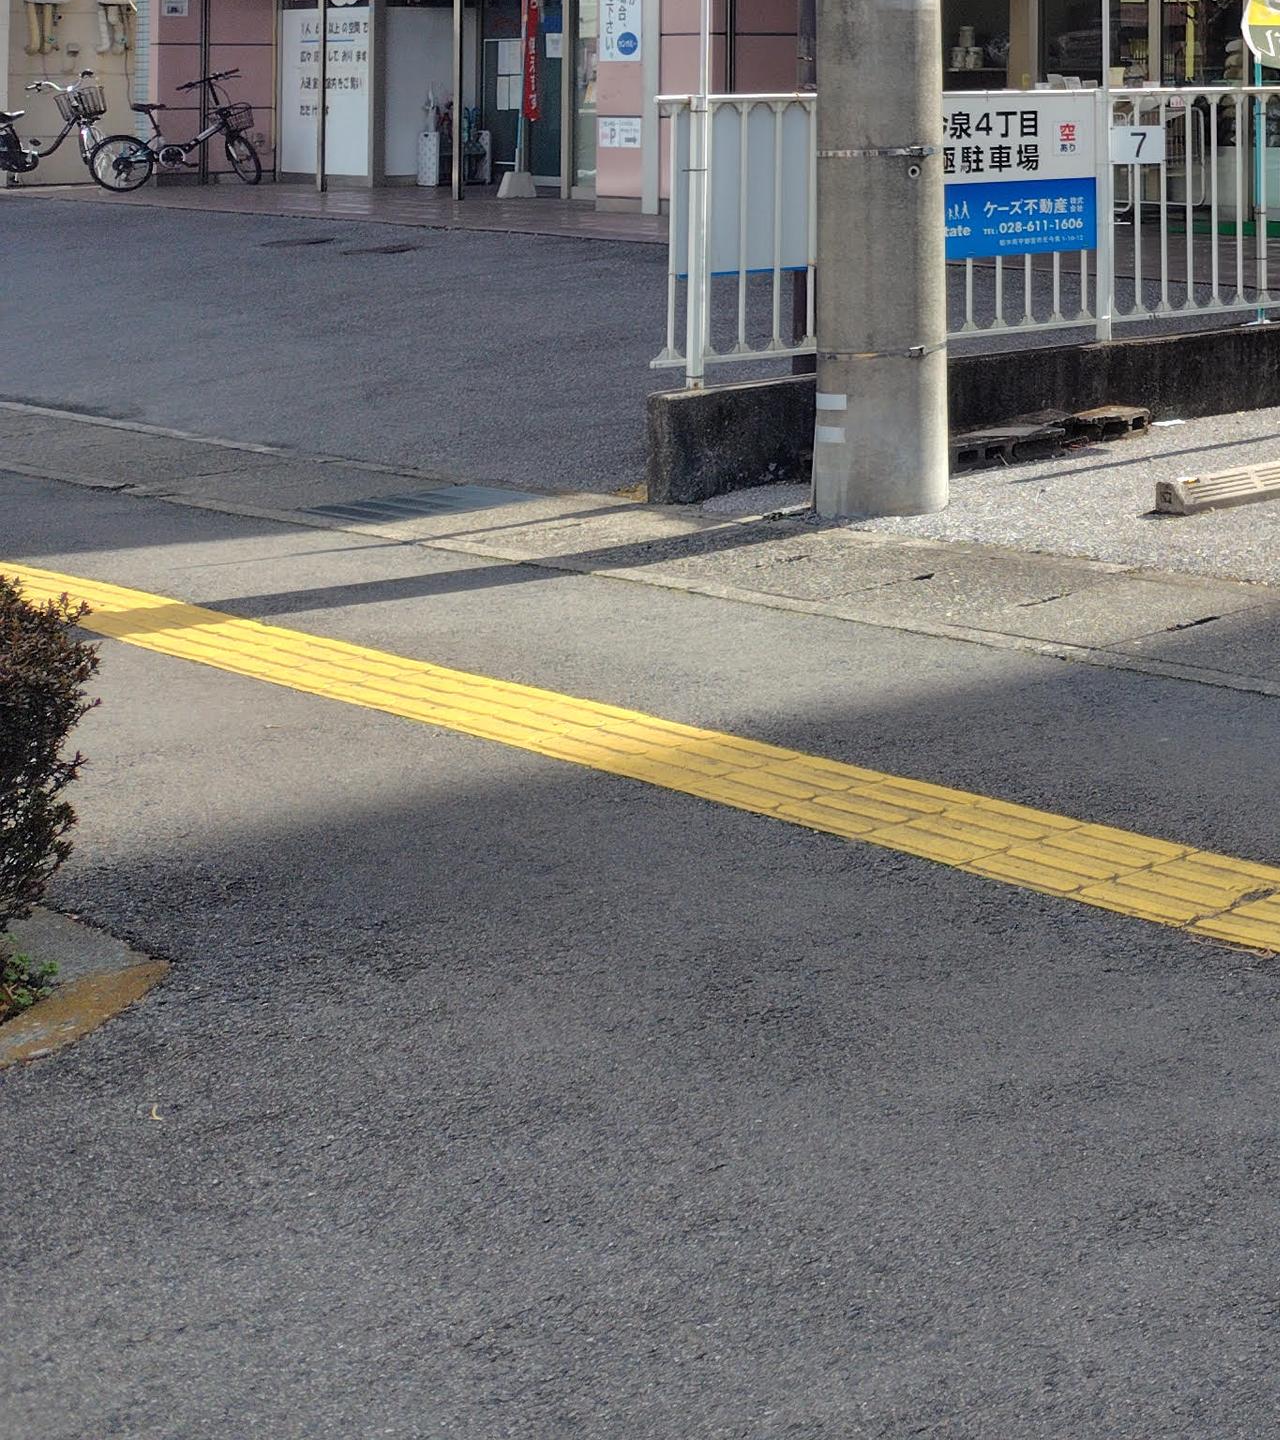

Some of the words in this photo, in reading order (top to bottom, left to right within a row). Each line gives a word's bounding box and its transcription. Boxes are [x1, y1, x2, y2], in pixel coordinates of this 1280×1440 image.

[942, 110, 1038, 139] 泉4丁目
[1060, 124, 1076, 142] 空
[1060, 144, 1076, 152] あり
[1130, 132, 1147, 158] 7
[983, 198, 1068, 218] ケーズ不動産
[999, 218, 1084, 234] 028-611-1606
